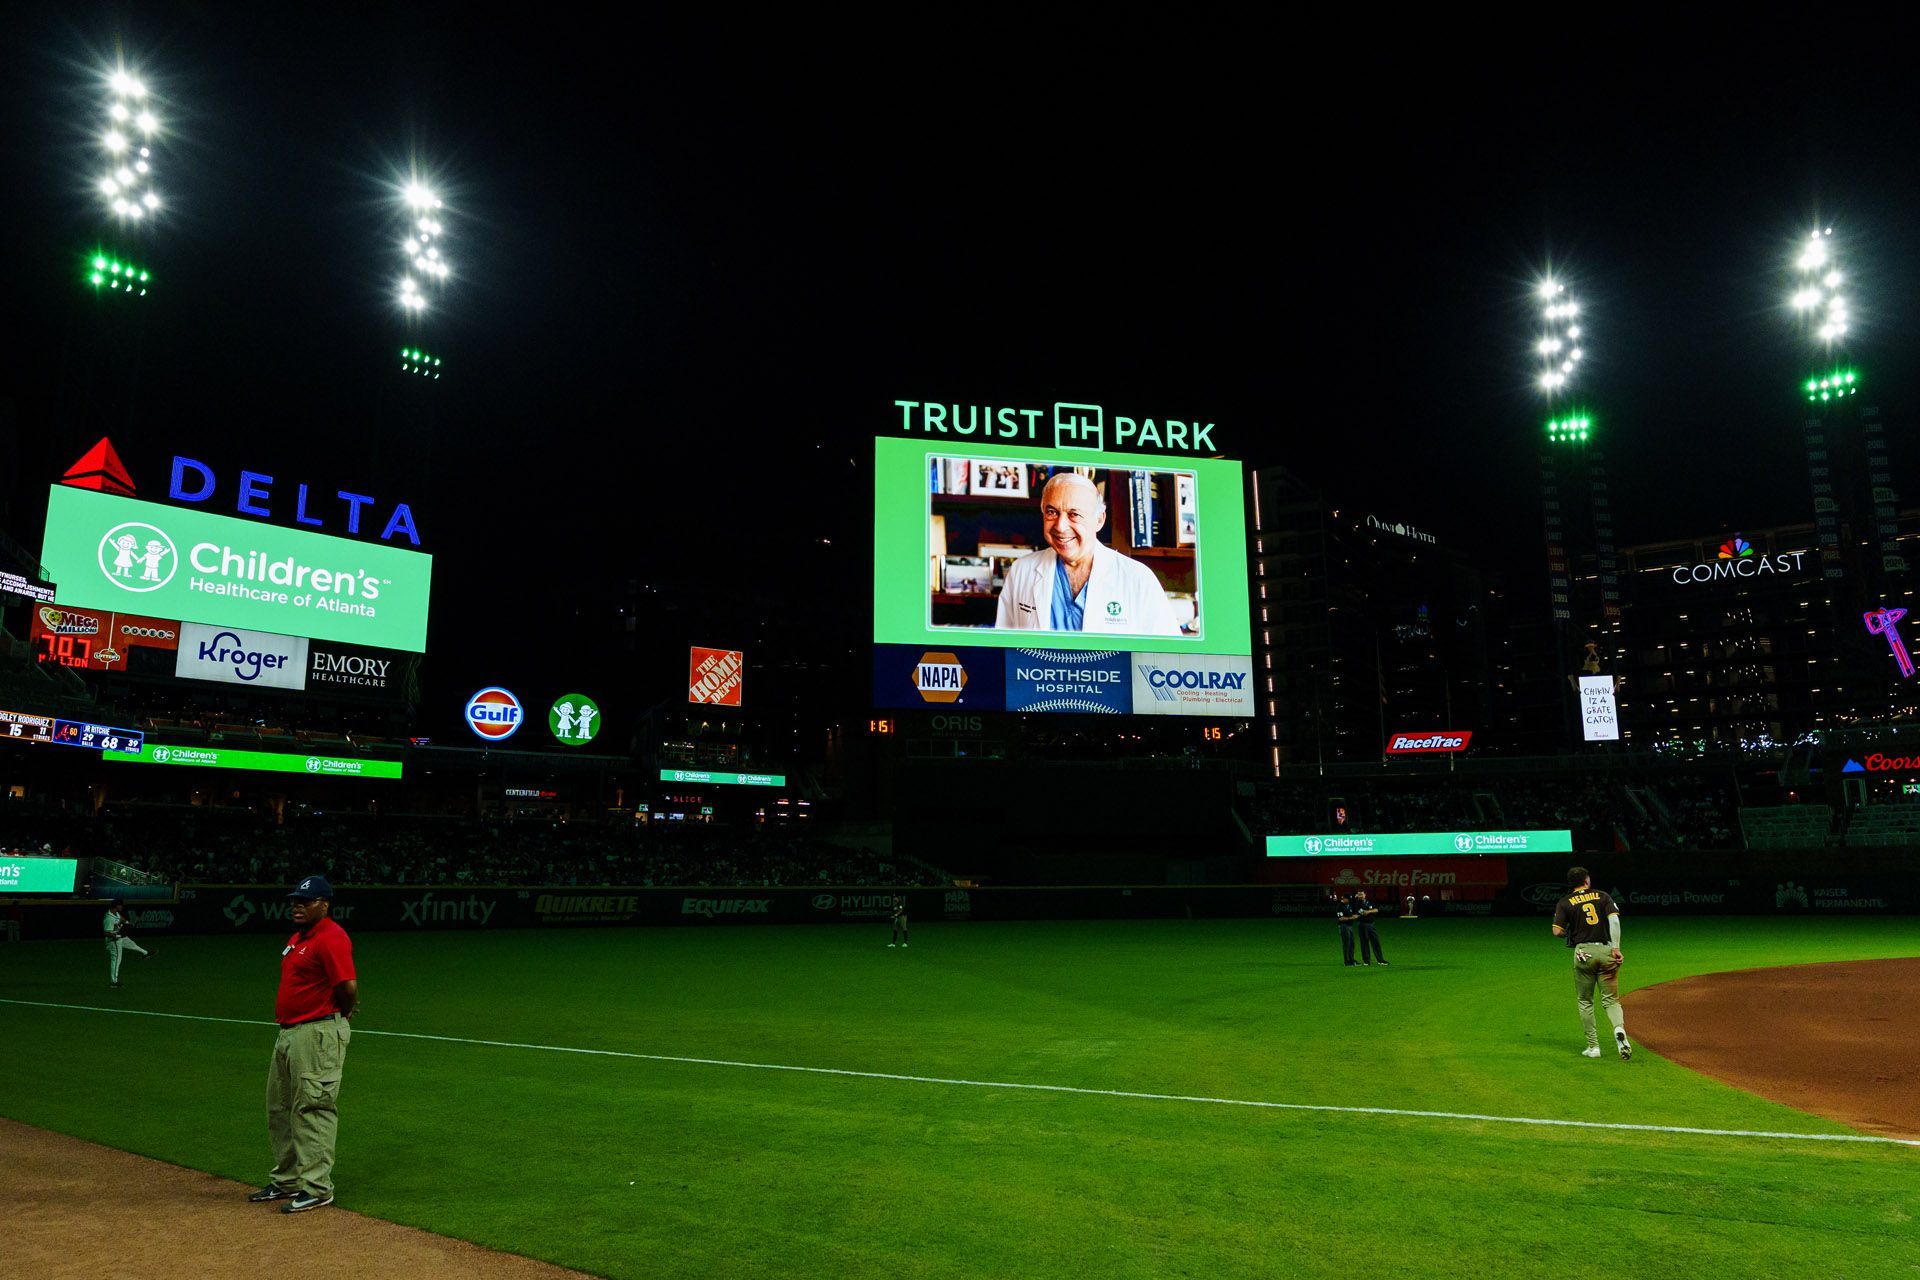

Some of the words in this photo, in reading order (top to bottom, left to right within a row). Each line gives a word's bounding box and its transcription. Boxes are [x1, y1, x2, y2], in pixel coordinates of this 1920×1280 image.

[895, 400, 1043, 439] TRUIST
[1115, 416, 1217, 451] PARK
[170, 456, 420, 545] DELTA
[190, 543, 380, 600] Children's
[1673, 553, 1805, 585] COMCAST
[2, 579, 54, 596] ACCOMPLISHMENTS
[190, 577, 288, 605] Healthcare
[294, 594, 311, 608] of
[315, 596, 376, 617] Atlanta
[60, 612, 98, 627] MEGA
[198, 632, 289, 681] Kroger
[313, 652, 391, 677] EMORY
[696, 654, 718, 675] THE
[312, 673, 386, 687] HEALTHCARE
[690, 651, 742, 702] HOME
[921, 666, 959, 688] NAPA
[1017, 668, 1121, 684] NORTHSIDE
[1148, 669, 1246, 690] COOLRAY
[710, 672, 741, 703] DEPOT
[1036, 684, 1103, 695] HOSPITAL
[1589, 697, 1598, 705] IZ
[18, 715, 49, 727] RODRIGUEZ
[470, 705, 519, 724] Gulf
[1586, 716, 1614, 724] CATCH
[10, 724, 23, 737] 15
[83, 725, 91, 733] JR
[91, 726, 110, 735] RITCHIE
[932, 715, 982, 731] ORIS
[40, 727, 47, 735] 11
[82, 733, 94, 741] 29
[101, 737, 119, 749] 68
[128, 739, 138, 747] 39
[1393, 736, 1462, 750] RaceTrac
[172, 749, 218, 760] Children's
[322, 759, 362, 770] Children's
[1324, 838, 1374, 847] Children's
[1475, 834, 1528, 844] Children's
[1569, 892, 1600, 906] MERRILL
[1629, 892, 1679, 905] Georgia
[1684, 891, 1725, 903] Power
[1814, 888, 1848, 897] KAISER
[400, 892, 496, 927] xfinity
[535, 895, 639, 913] QUIKRETE
[681, 898, 770, 917] EQUIFAX
[1815, 899, 1884, 908] PERMANENTE
[1582, 903, 1599, 925] 3
